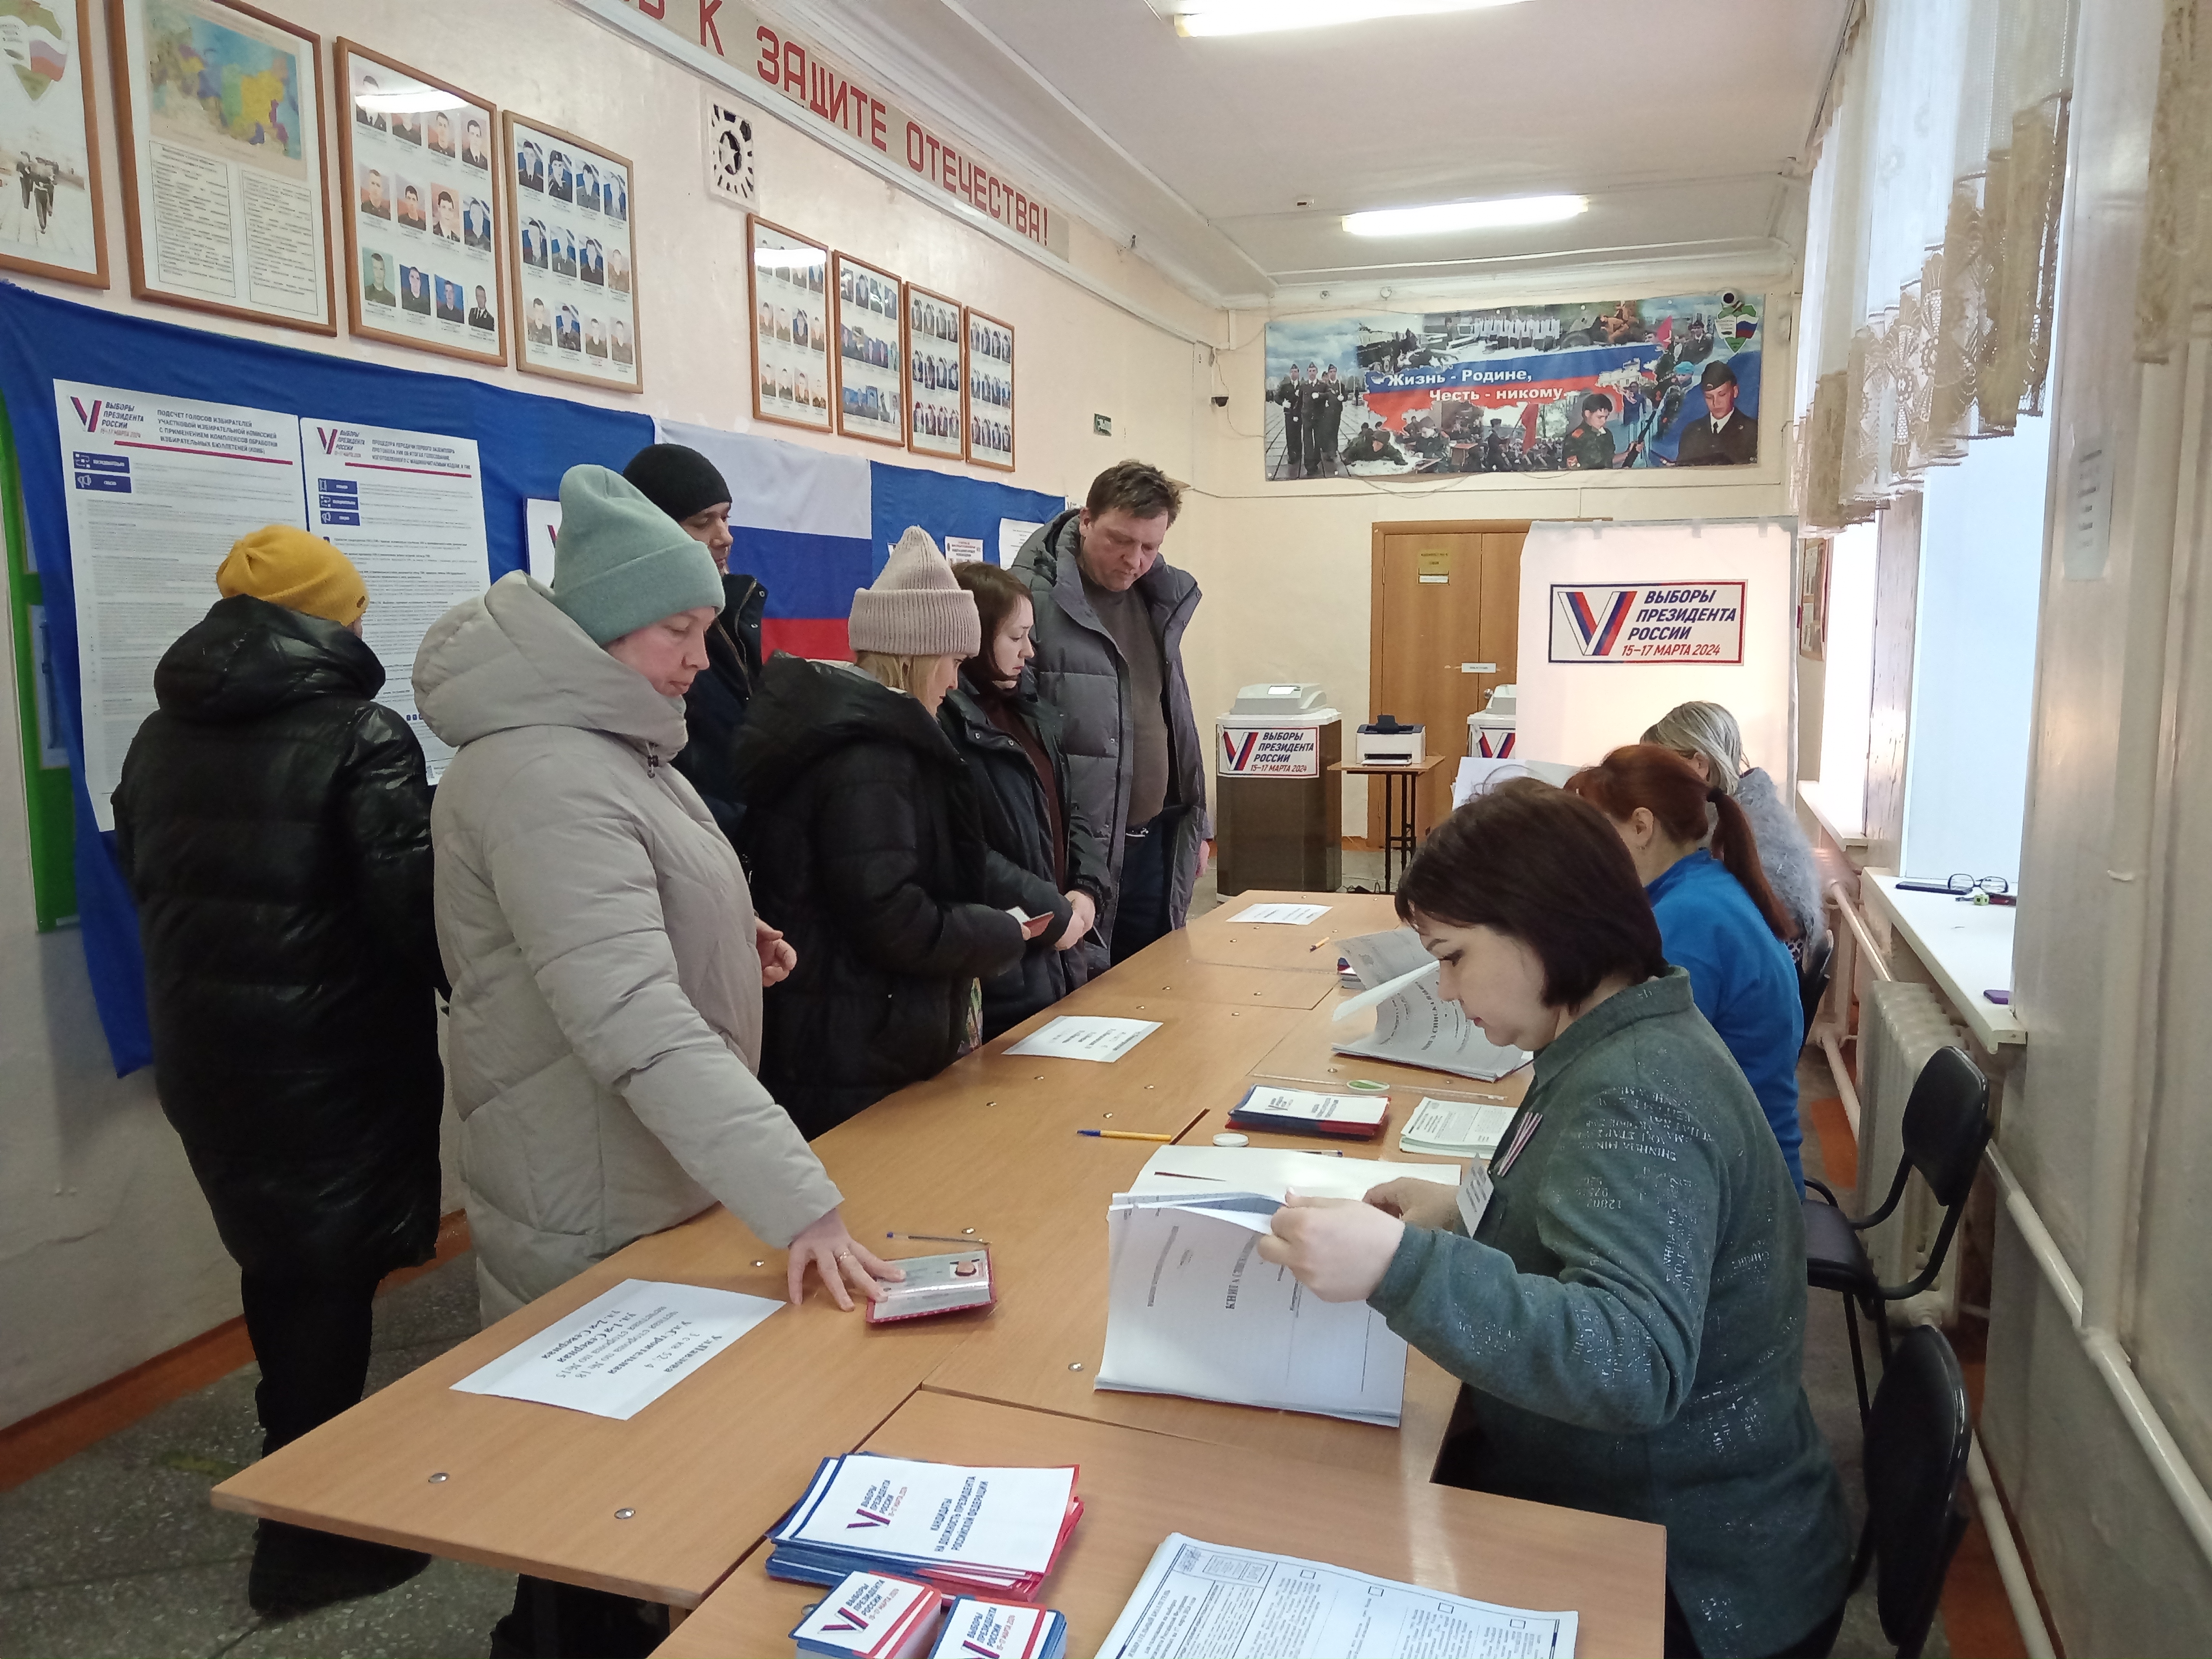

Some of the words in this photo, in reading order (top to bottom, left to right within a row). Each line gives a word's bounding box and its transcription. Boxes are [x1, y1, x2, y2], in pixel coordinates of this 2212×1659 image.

[757, 25, 887, 152] ЗАЩИТЕ
[906, 121, 1049, 247] ОТЕЧЕСТВА!
[1387, 373, 1446, 387] Жизнь
[1462, 369, 1532, 383] Родине,
[1429, 390, 1480, 401] Честь
[105, 401, 135, 412] ВЫБОРЫ
[102, 419, 128, 429] РОССИИ
[103, 411, 144, 422] ПРЕЗИДЕНТА
[157, 409, 184, 419] ПОДСЧЕТ
[185, 413, 212, 422] ГОЛОСОВ
[213, 417, 253, 428] ИЗБИРАТЕЛЕЙ
[158, 418, 196, 428] УЧАСТКОВОЙ
[197, 424, 245, 435] ИЗБИРАТЕЛЬНОЙ
[165, 428, 209, 439] ПРИМЕНЕНИЕМ
[160, 436, 211, 447] ИЗБИРАТЕЛЬНЫХ
[1644, 589, 1717, 605] ВЫБОРЫ
[1635, 608, 1737, 624] ПРЕЗИДЕНТА
[1627, 626, 1692, 641] РОССИИ
[1622, 644, 1653, 657] 15–17
[1653, 644, 1691, 656] МАРТА
[1692, 644, 1721, 656] 2024
[1262, 732, 1304, 741] ВЫБОРЫ
[1258, 742, 1314, 753] ПРЕЗИДЕНТА
[1253, 754, 1291, 763] РОССИИ
[542, 1330, 591, 1359] Северная
[557, 1333, 606, 1362] Северная
[591, 1331, 629, 1354] сторона
[613, 1329, 650, 1352] сторона
[860, 1485, 877, 1507] ВЫБОРЫ
[870, 1480, 890, 1510] ПРЕЗИДЕНТА
[879, 1494, 894, 1514] РОССИИ
[846, 1583, 869, 1606] ВЫБОРЫ
[853, 1580, 885, 1611] ПРЕЗИДЕНТА
[861, 1594, 882, 1616] РОССИИ
[967, 1612, 983, 1638] ВЫБОРЫ
[987, 1623, 1002, 1648] РОССИИ
